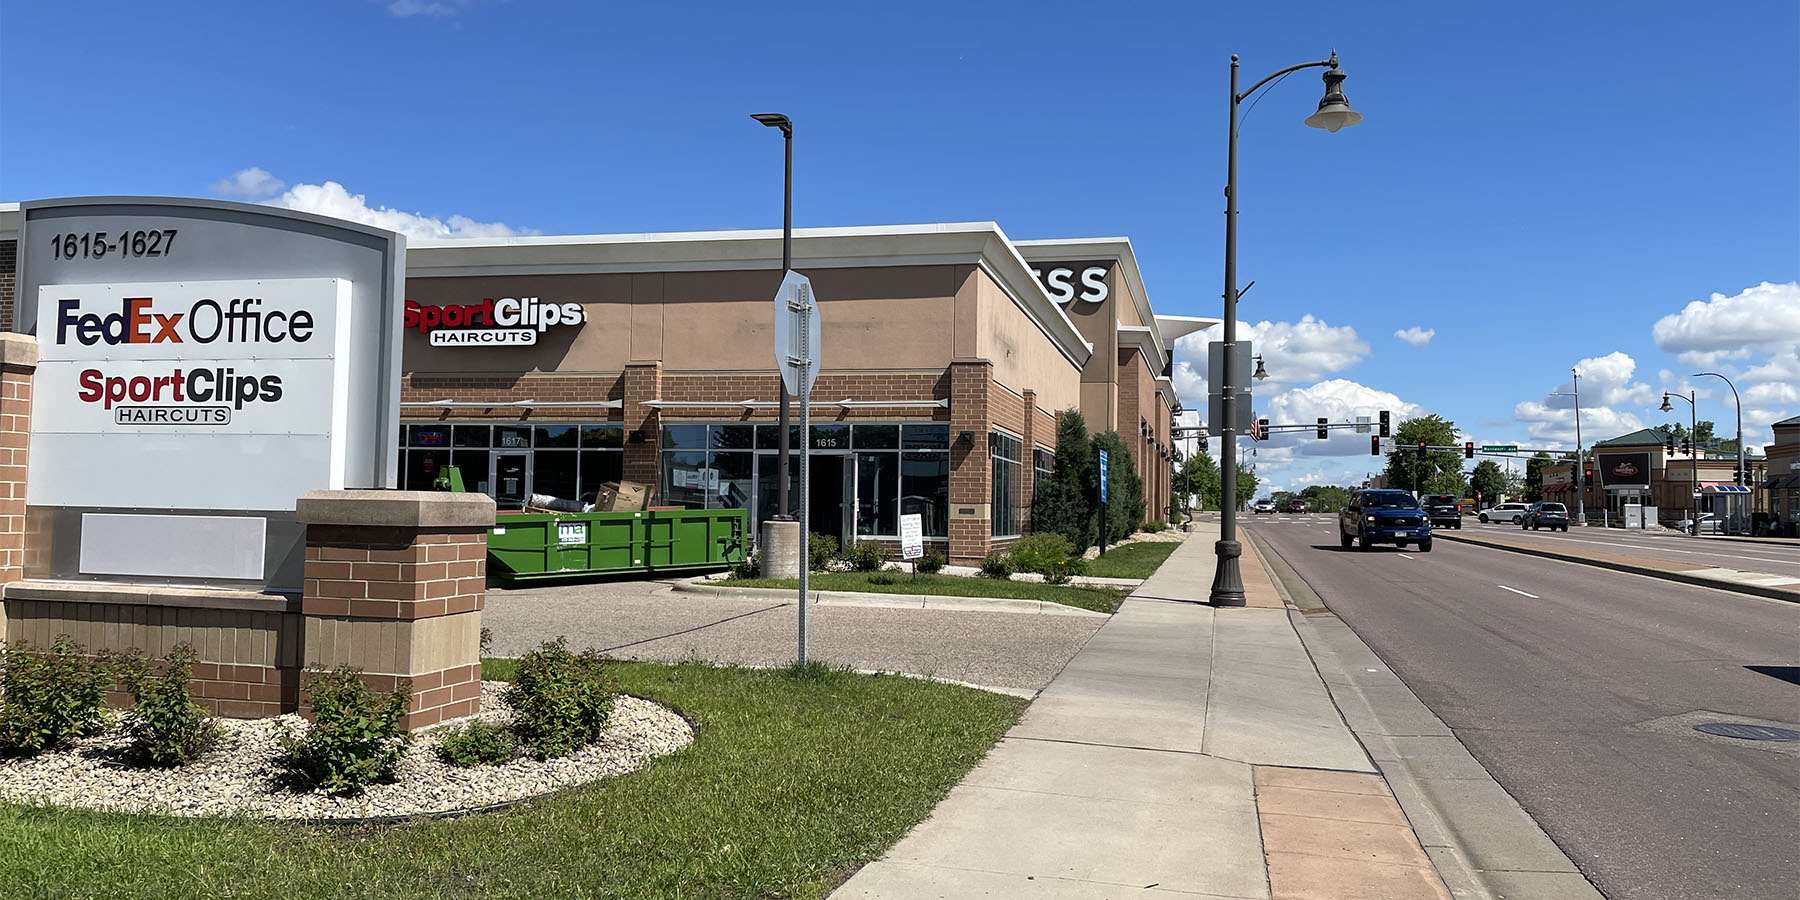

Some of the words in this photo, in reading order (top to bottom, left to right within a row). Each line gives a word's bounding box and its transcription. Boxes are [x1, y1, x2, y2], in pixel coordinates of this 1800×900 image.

[51, 229, 178, 260] 1615-1627
[1033, 266, 1108, 304] SS
[56, 297, 184, 346] FedEx
[189, 298, 314, 343] Office
[404, 297, 583, 334] SportClips
[434, 332, 532, 343] HAIRCUTS
[79, 368, 283, 410] SportClips
[119, 409, 227, 422] HAIRCUTS
[502, 437, 521, 446] 1617
[816, 438, 837, 447] 1615
[561, 524, 583, 534] ma
